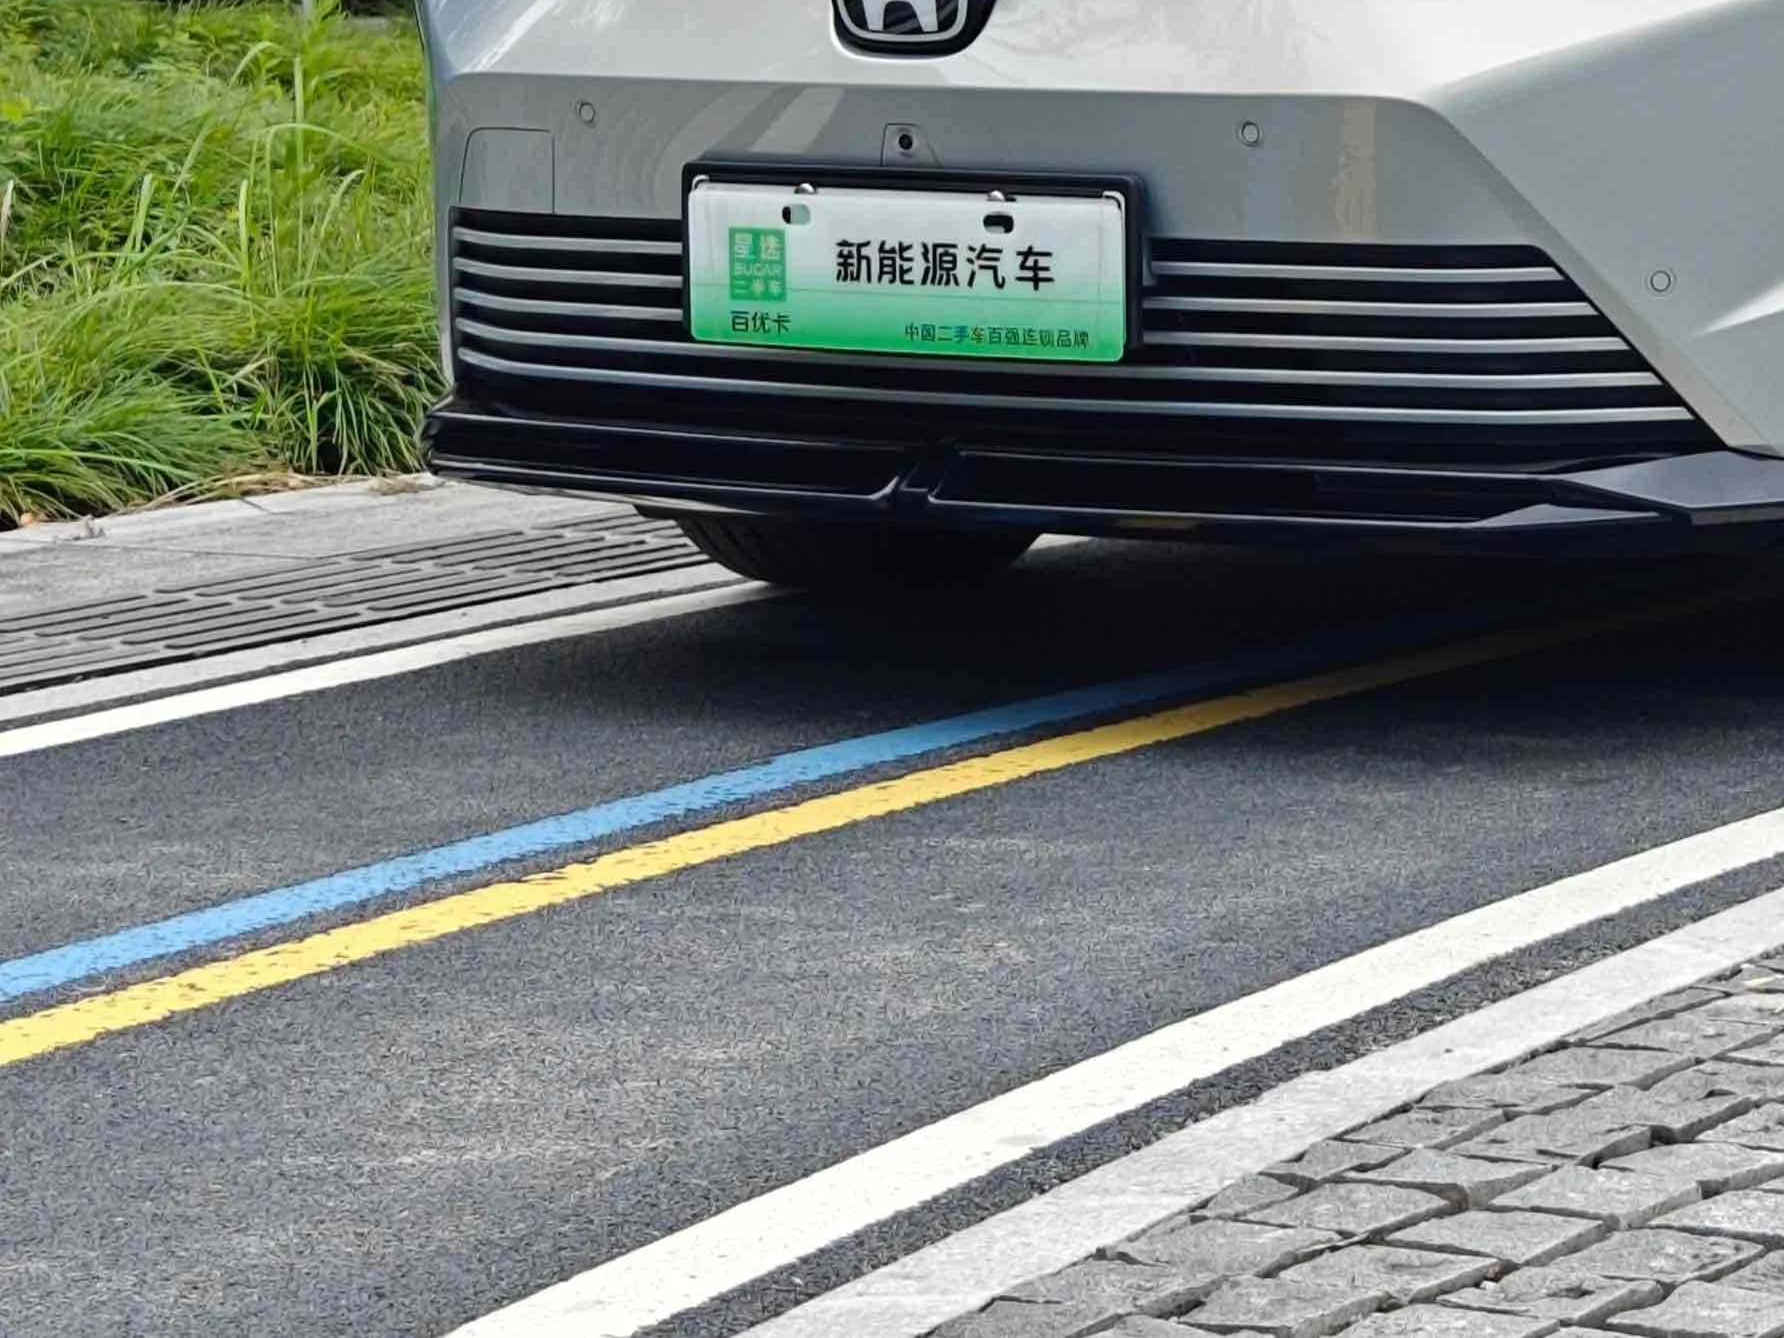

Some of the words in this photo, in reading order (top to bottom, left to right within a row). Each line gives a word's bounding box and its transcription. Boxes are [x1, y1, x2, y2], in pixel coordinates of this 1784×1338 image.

[835, 239, 1055, 292] 新能源汽车
[730, 310, 792, 335] 百优卡
